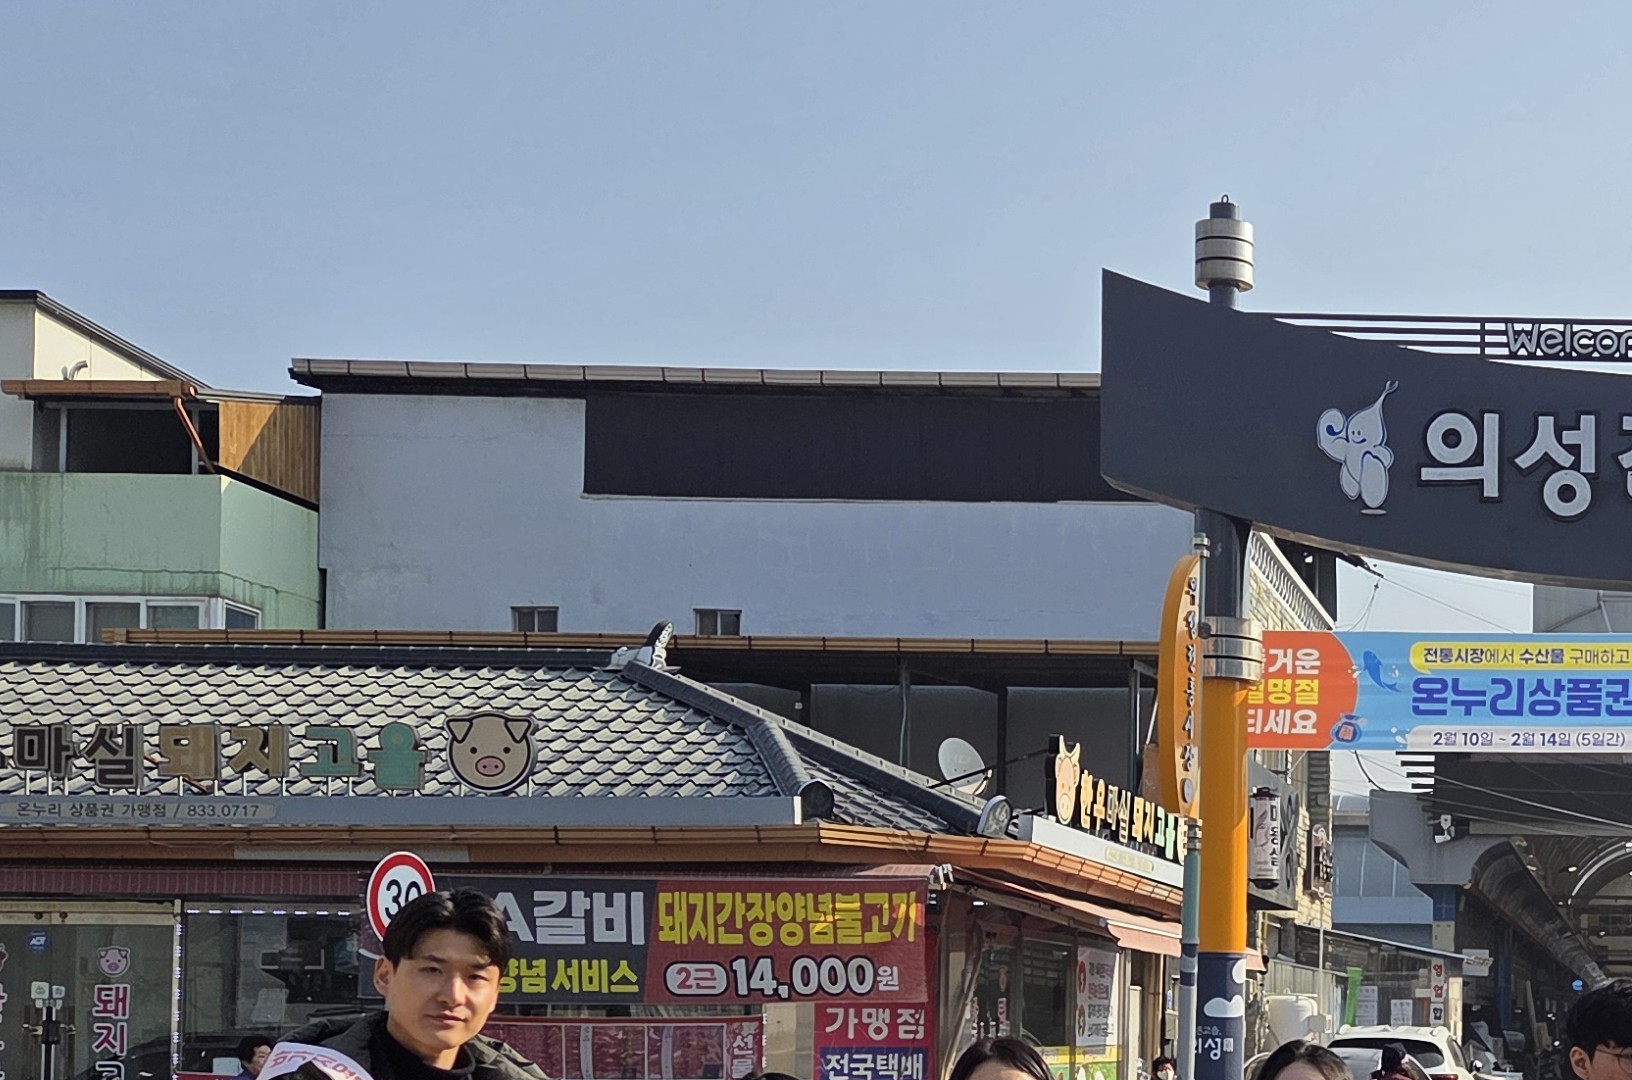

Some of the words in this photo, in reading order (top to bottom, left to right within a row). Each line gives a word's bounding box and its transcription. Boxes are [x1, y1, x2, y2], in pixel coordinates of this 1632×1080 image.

[1260, 647, 1321, 675] 거운
[1424, 647, 1514, 664] 전통시장에서
[1519, 648, 1564, 664] 수산물
[1569, 648, 1630, 664] 구매하고
[1433, 732, 1457, 746] 2월
[1463, 732, 1493, 746] 10일
[1511, 732, 1535, 746] 2월
[1540, 732, 1570, 746] 14일
[1576, 731, 1626, 747] (5일간)
[16, 803, 62, 817] 온누리
[68, 803, 115, 817] 상품권
[122, 803, 167, 818] 가맹점
[187, 805, 260, 819] 833.0717
[657, 890, 917, 947] 돼지간장양념불고기
[551, 958, 640, 993] 서비스
[675, 966, 717, 990] 2근
[825, 1007, 926, 1041] 가맹점
